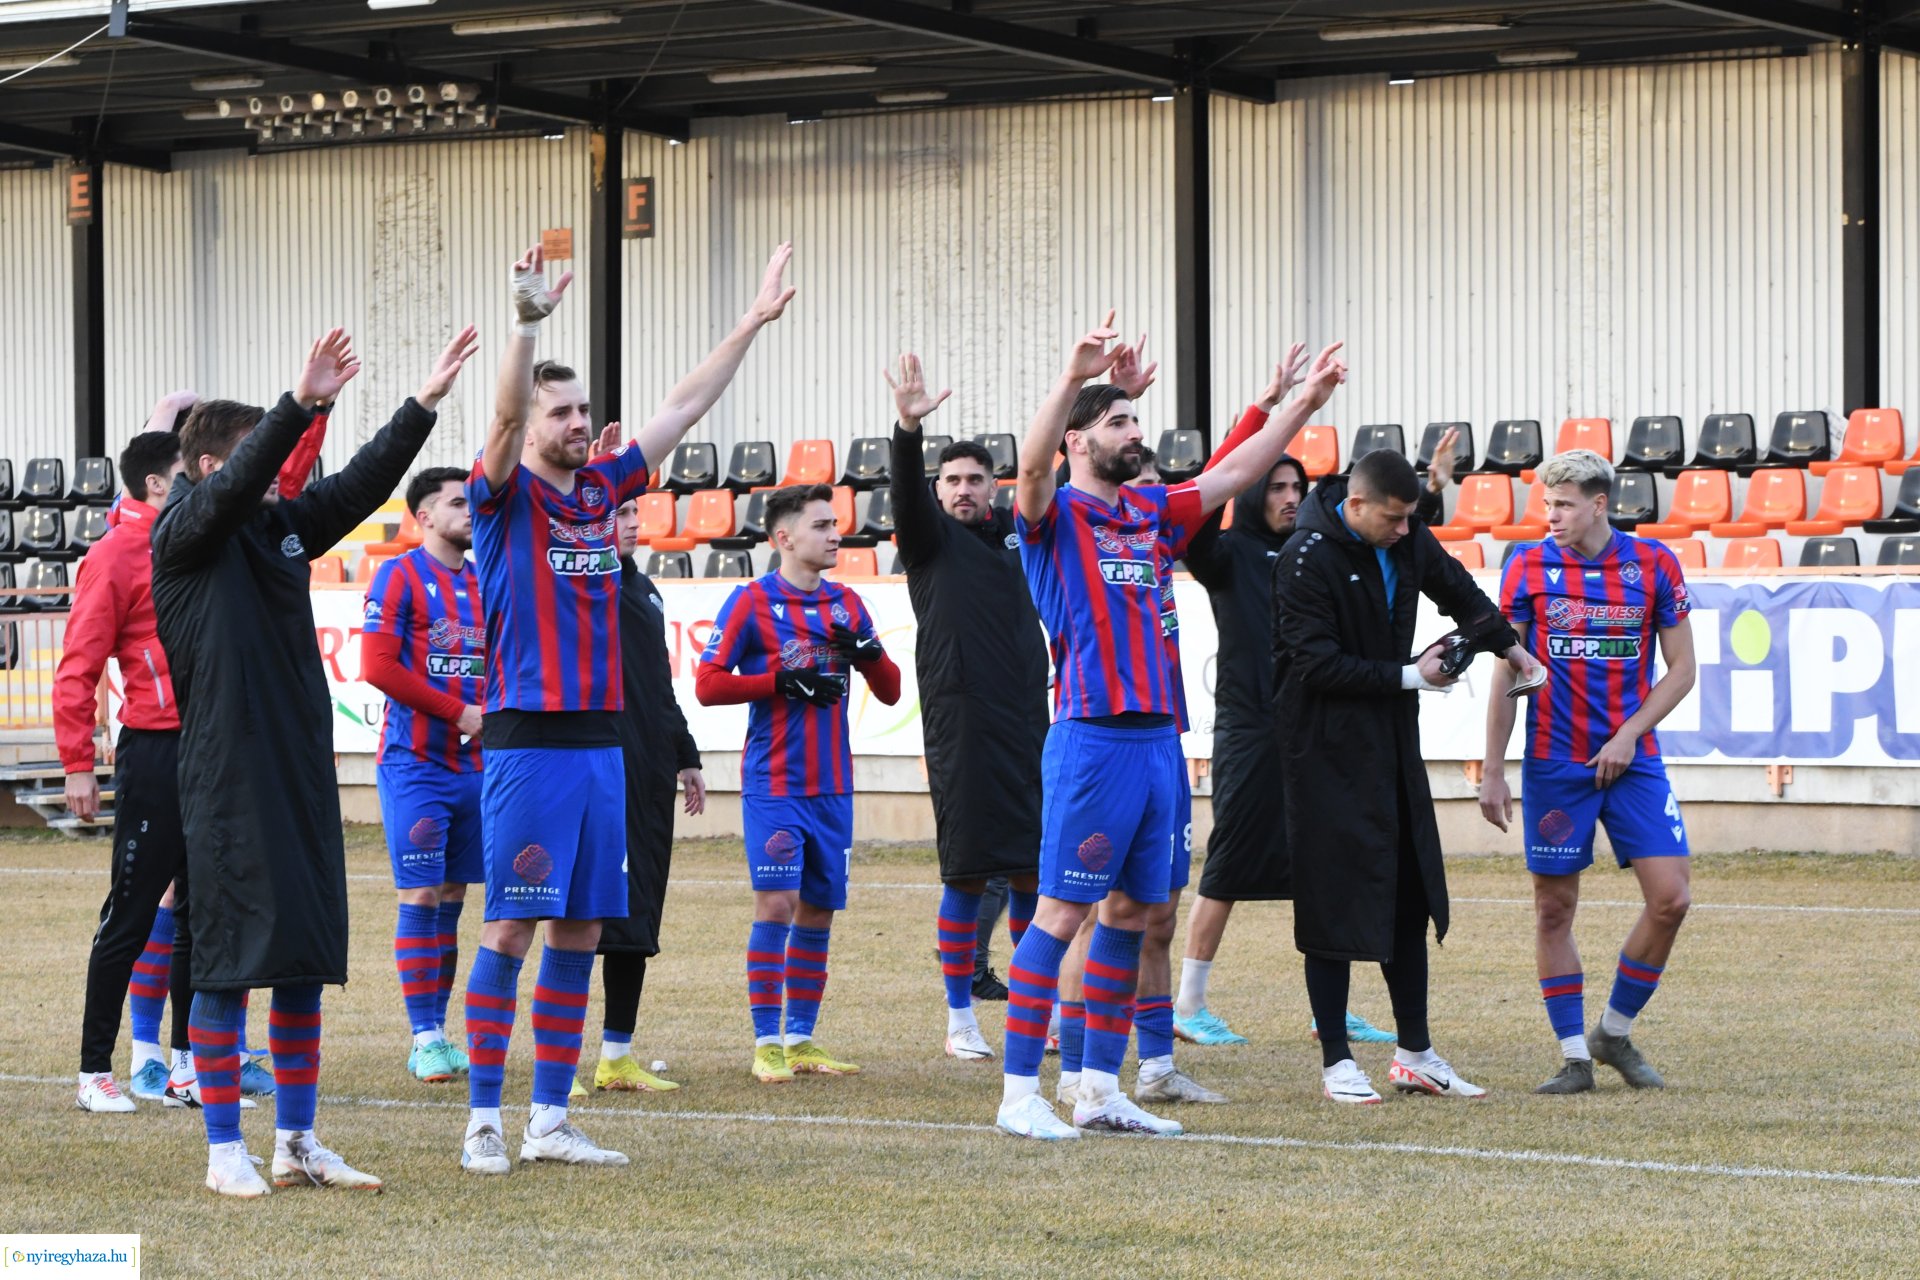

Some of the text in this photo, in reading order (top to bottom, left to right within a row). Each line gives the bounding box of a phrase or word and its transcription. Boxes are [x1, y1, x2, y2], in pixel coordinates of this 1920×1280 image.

[70, 173, 89, 208] E
[628, 185, 647, 220] F
[1102, 563, 1157, 586] TiPPM
[1583, 606, 1646, 619] REVESZ
[430, 657, 485, 674] TiPPM
[1653, 608, 1920, 734] TiP
[1531, 845, 1582, 854] PRESTIGE
[504, 886, 561, 895] PRESTIGE
